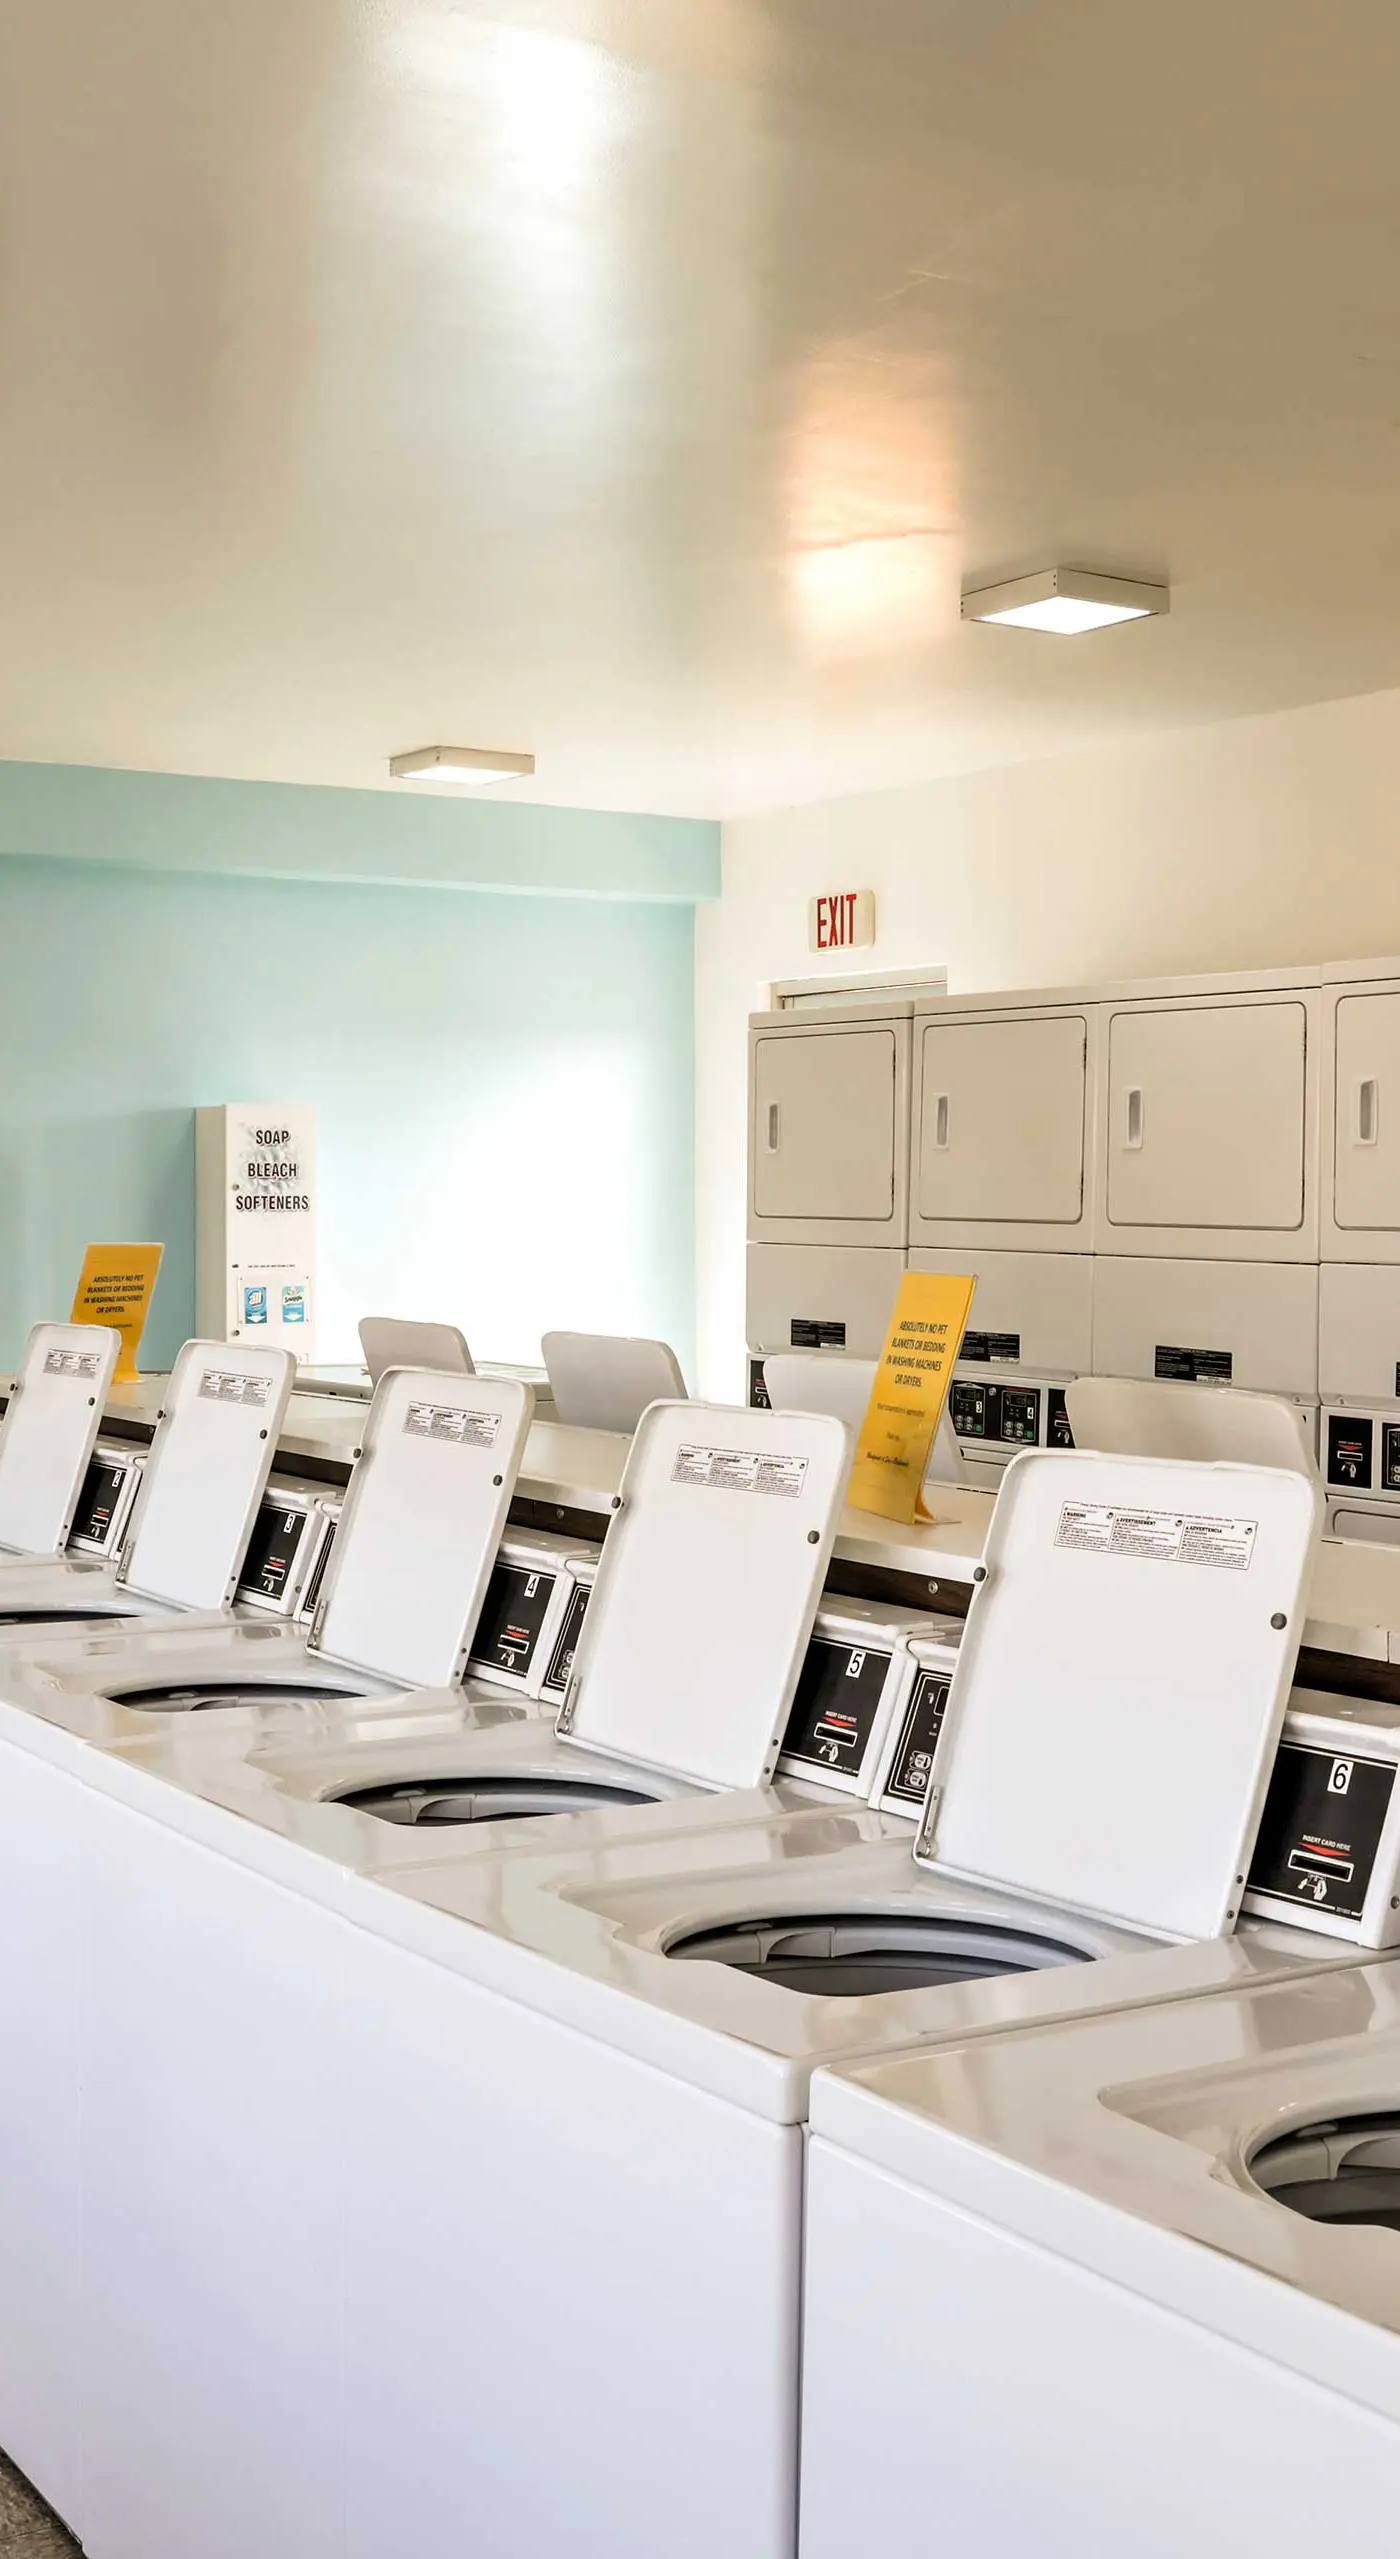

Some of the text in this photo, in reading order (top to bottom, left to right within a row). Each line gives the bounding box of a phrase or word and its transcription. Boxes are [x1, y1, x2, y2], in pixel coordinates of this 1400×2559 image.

[817, 894, 857, 948] EXIT
[255, 1130, 290, 1145] SOAP
[247, 1162, 297, 1178] BLEACH
[236, 1195, 309, 1211] SOFTENERS
[93, 1275, 125, 1283] ABSOLUTELY
[125, 1274, 134, 1282] NO
[900, 1321, 948, 1335] ABSOLUTELY NO PET
[891, 1337, 946, 1353] BLANKETS OR BEDDING
[886, 1354, 942, 1372] IN WASHING MACHINES
[894, 1374, 903, 1385] OR
[1027, 1408, 1034, 1419] 4
[285, 1515, 295, 1531] 3
[527, 1577, 538, 1595] 4
[850, 1653, 863, 1674] 5
[1333, 1763, 1349, 1790] 6
[1302, 1834, 1351, 1851] INSERT CARD HERE
